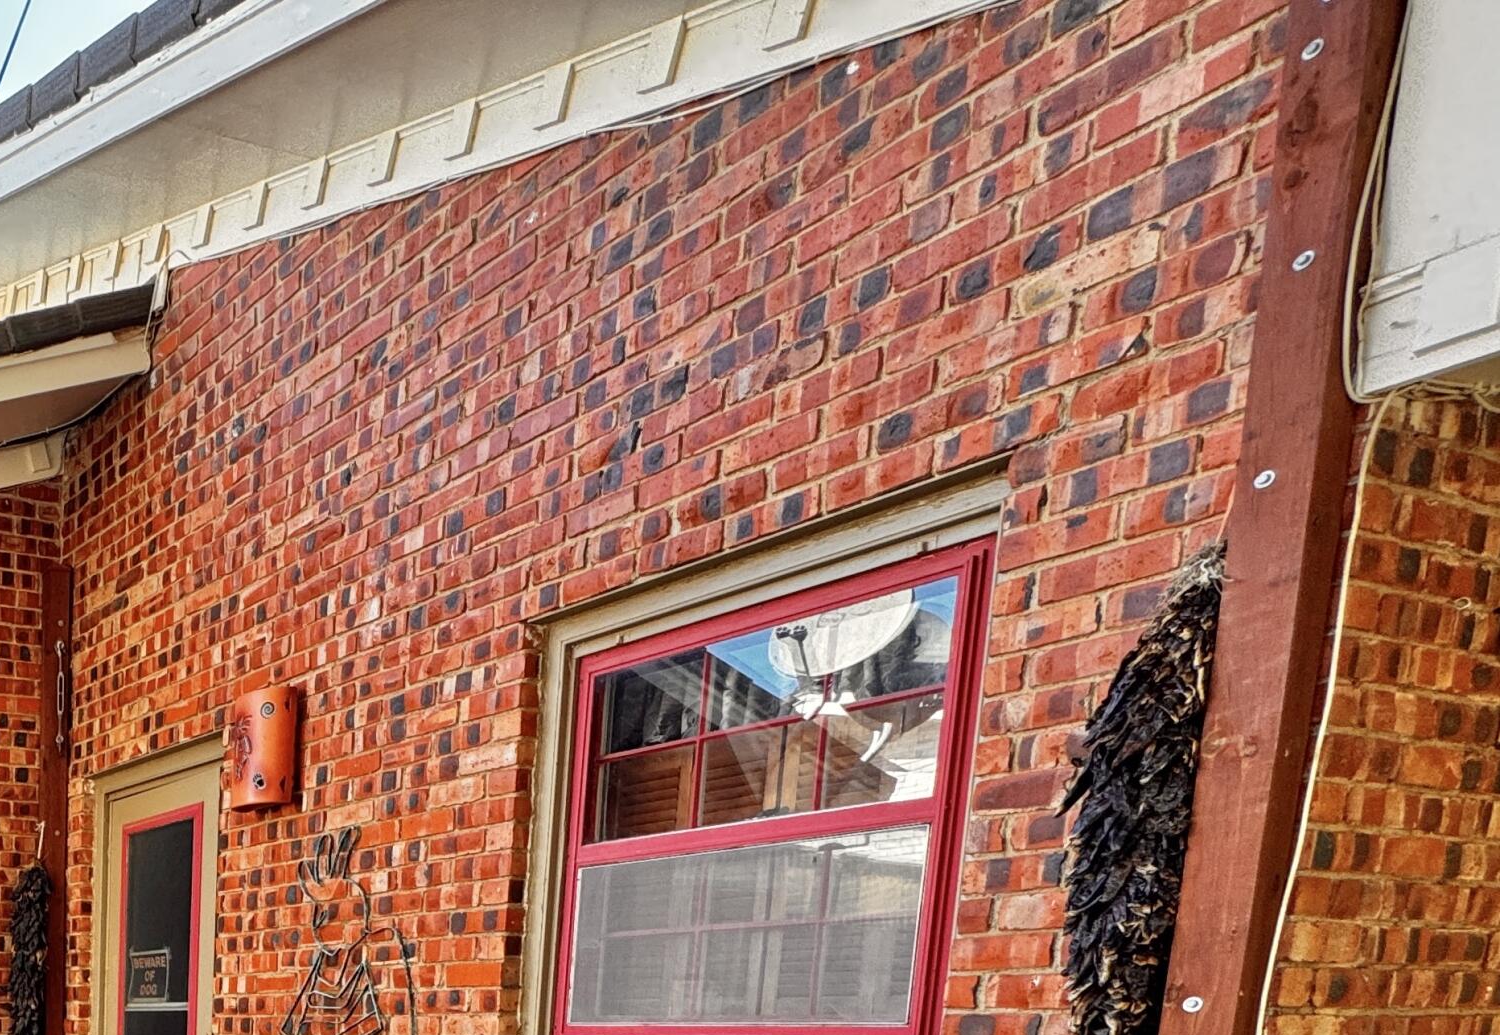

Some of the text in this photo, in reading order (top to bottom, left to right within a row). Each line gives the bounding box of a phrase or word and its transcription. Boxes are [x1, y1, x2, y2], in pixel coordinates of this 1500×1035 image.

[133, 956, 166, 969] BEWARE
[144, 970, 156, 982] OF
[140, 984, 157, 995] DOG
